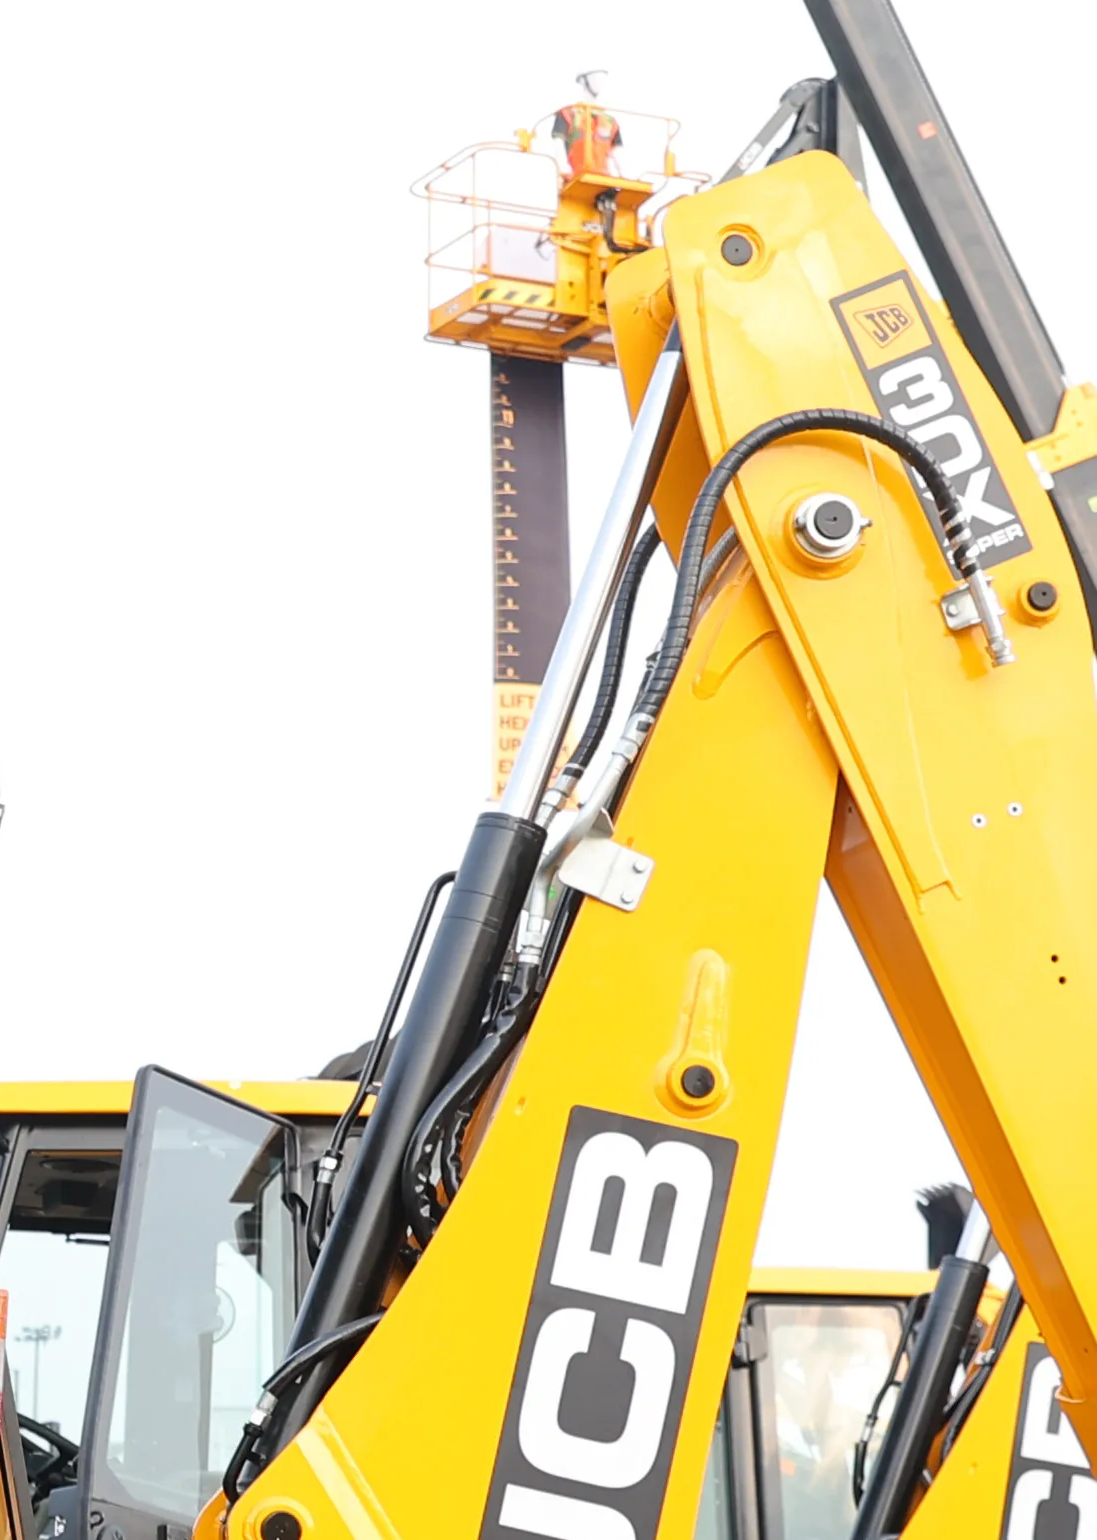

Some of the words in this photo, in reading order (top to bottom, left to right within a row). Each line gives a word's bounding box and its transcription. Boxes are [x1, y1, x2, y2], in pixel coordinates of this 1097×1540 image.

[864, 306, 909, 342] JCB
[946, 523, 1024, 565] PER
[499, 693, 535, 709] LIFT
